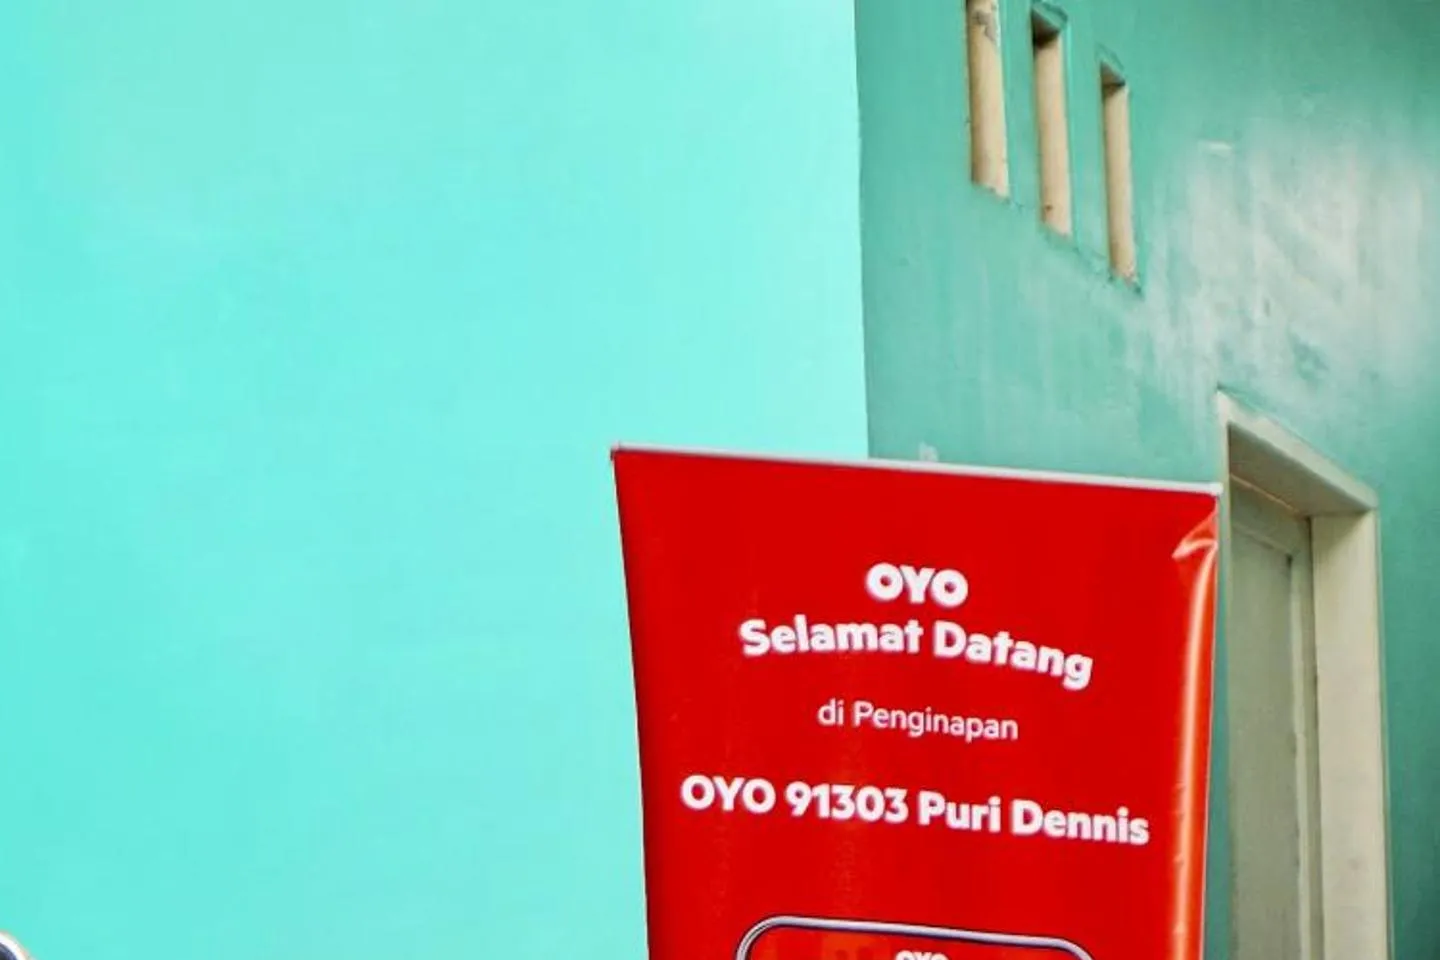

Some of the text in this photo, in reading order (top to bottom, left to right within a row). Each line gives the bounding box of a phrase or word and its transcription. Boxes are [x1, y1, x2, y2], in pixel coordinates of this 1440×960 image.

[865, 563, 968, 607] OYO
[740, 615, 1093, 690] Selamat Datang
[817, 699, 1018, 742] di Penginapan
[680, 775, 1150, 845] OYO 91303 Puri Dennis
